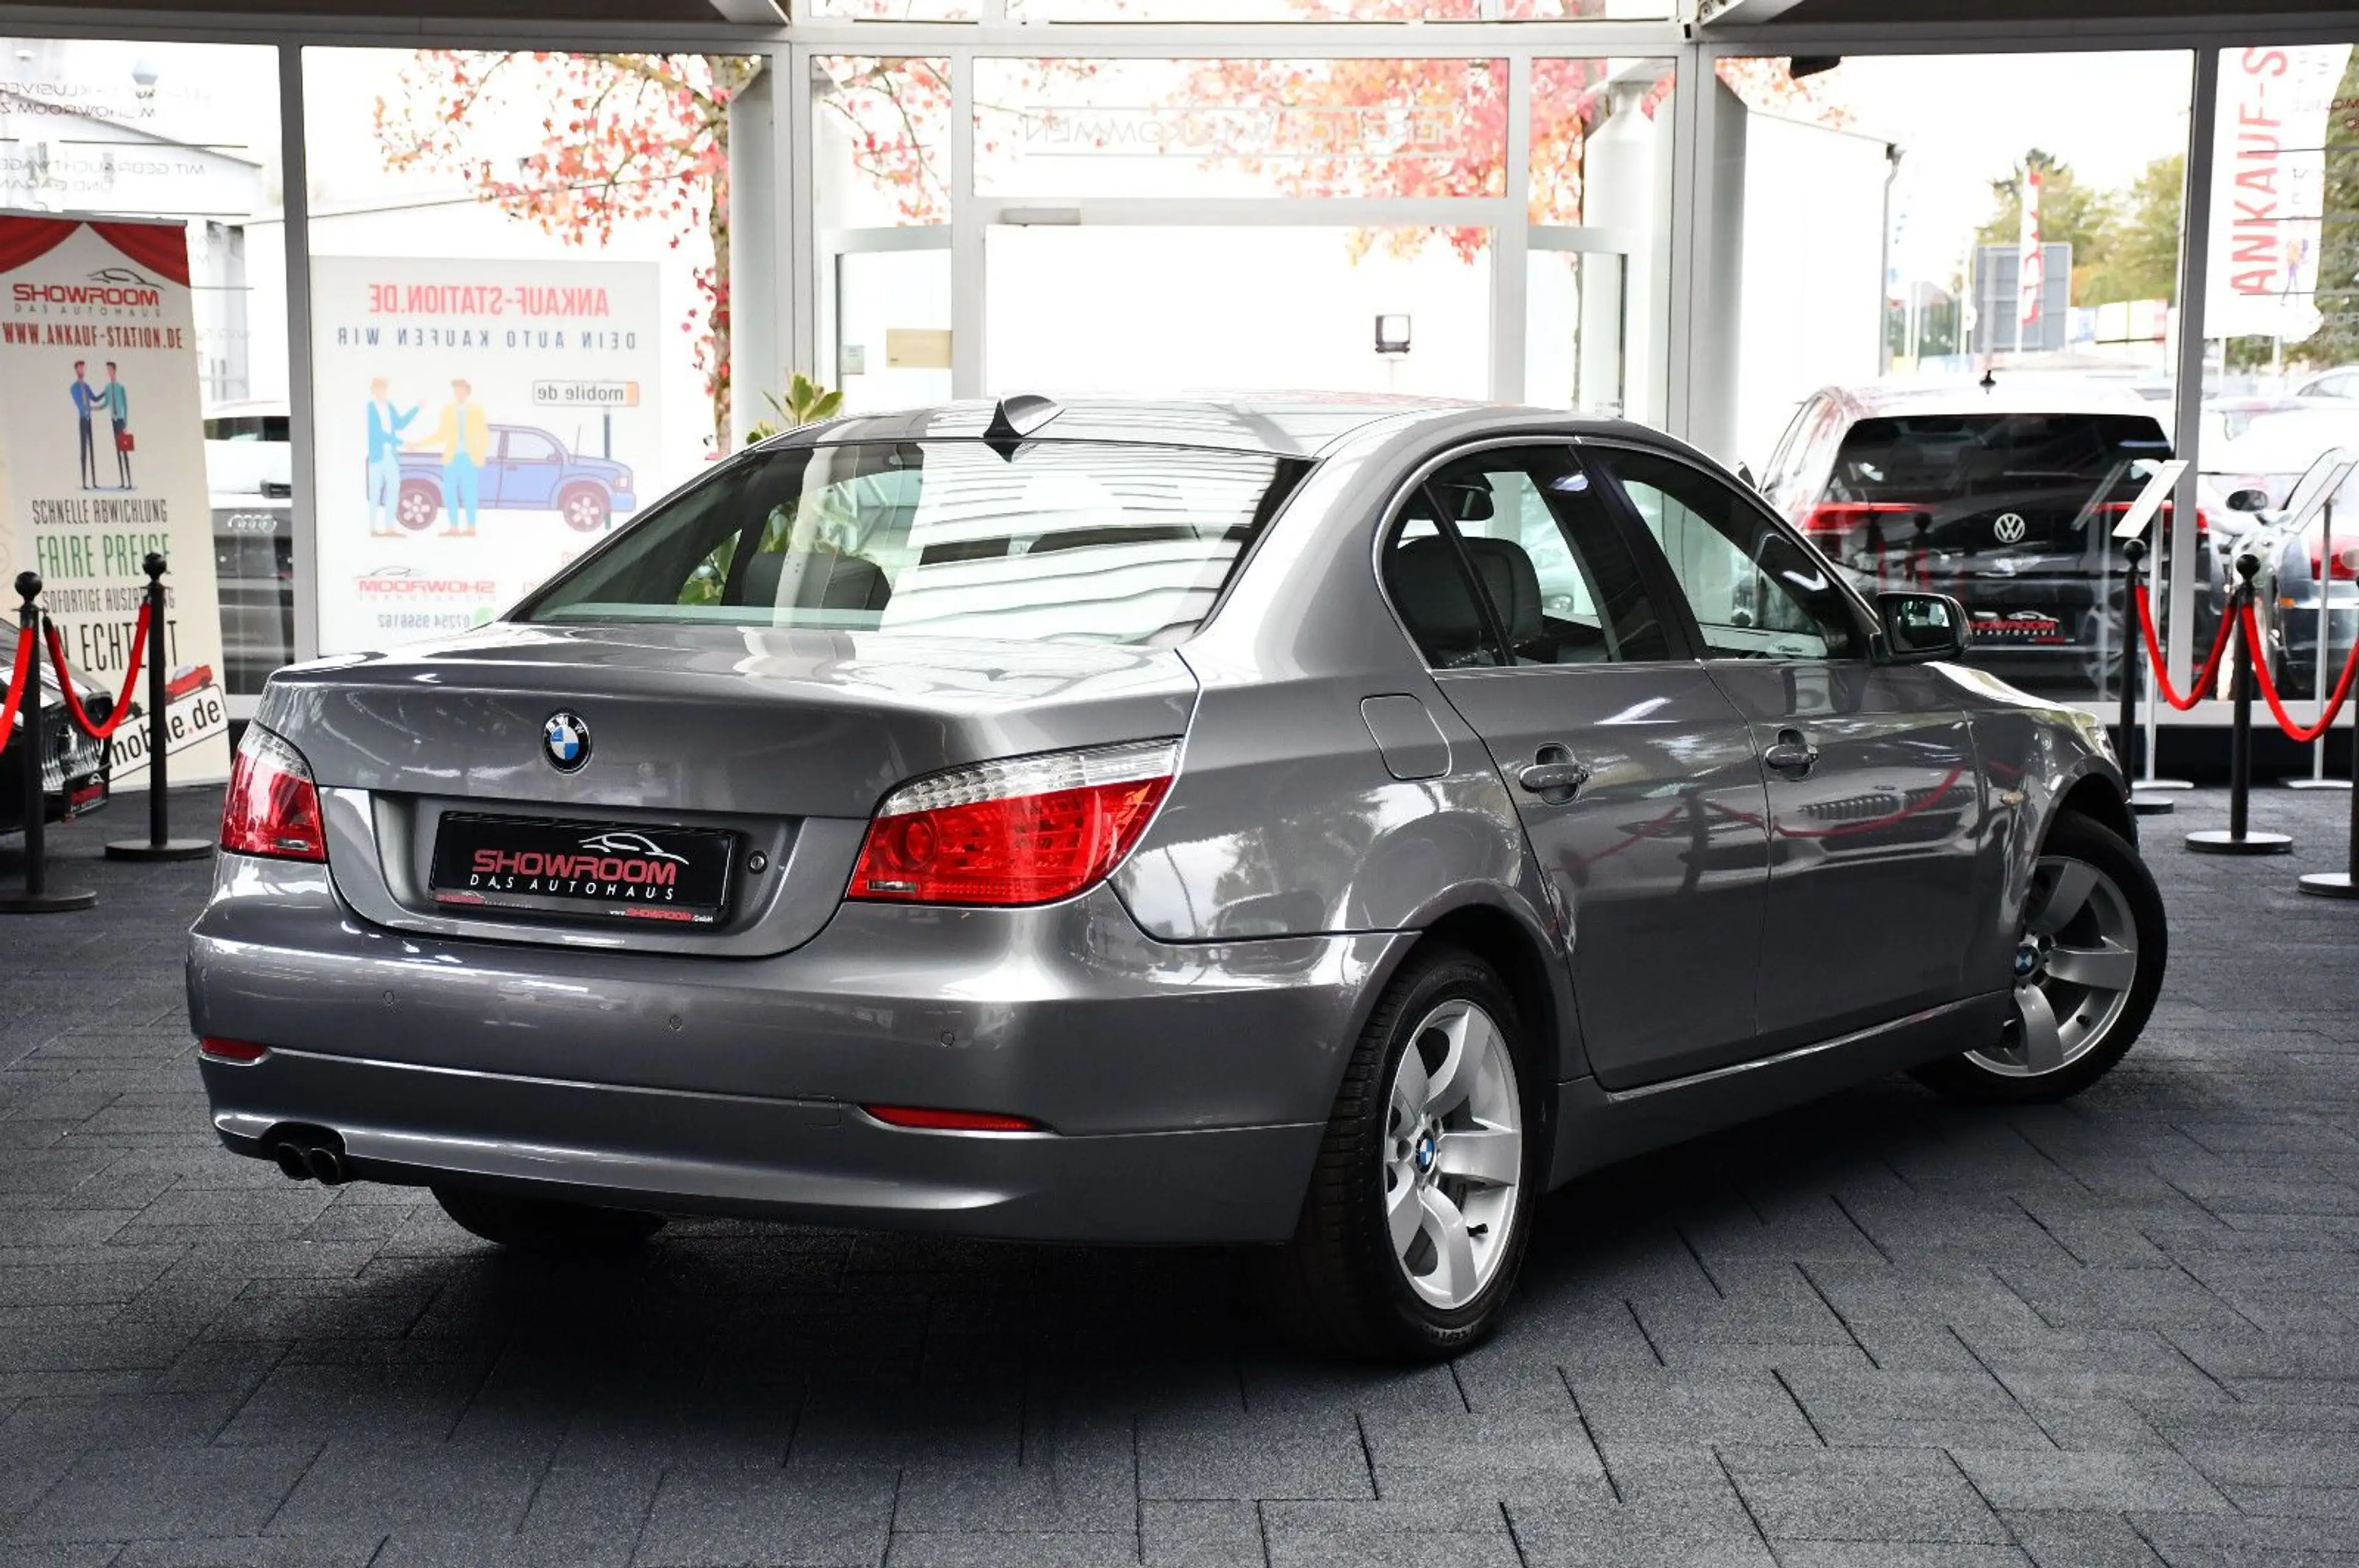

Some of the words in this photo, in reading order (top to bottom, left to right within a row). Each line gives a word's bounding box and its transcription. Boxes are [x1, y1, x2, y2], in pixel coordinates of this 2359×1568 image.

[12, 283, 160, 307] SHOWROOM
[2, 321, 183, 349] WWW.ANKAUF-STATION.DE
[32, 499, 89, 525] SCHNELLE
[36, 534, 95, 579] FAIRE
[42, 588, 101, 614] SOFORTIGE
[105, 586, 176, 611] AUSZAG
[1970, 619, 2057, 631] HOWROOM
[80, 620, 177, 672] ECHTT
[111, 698, 221, 766] moble.de
[472, 849, 676, 886] SHOWROOM
[469, 874, 515, 889] DAS
[529, 880, 674, 900] AUTOHAUS
